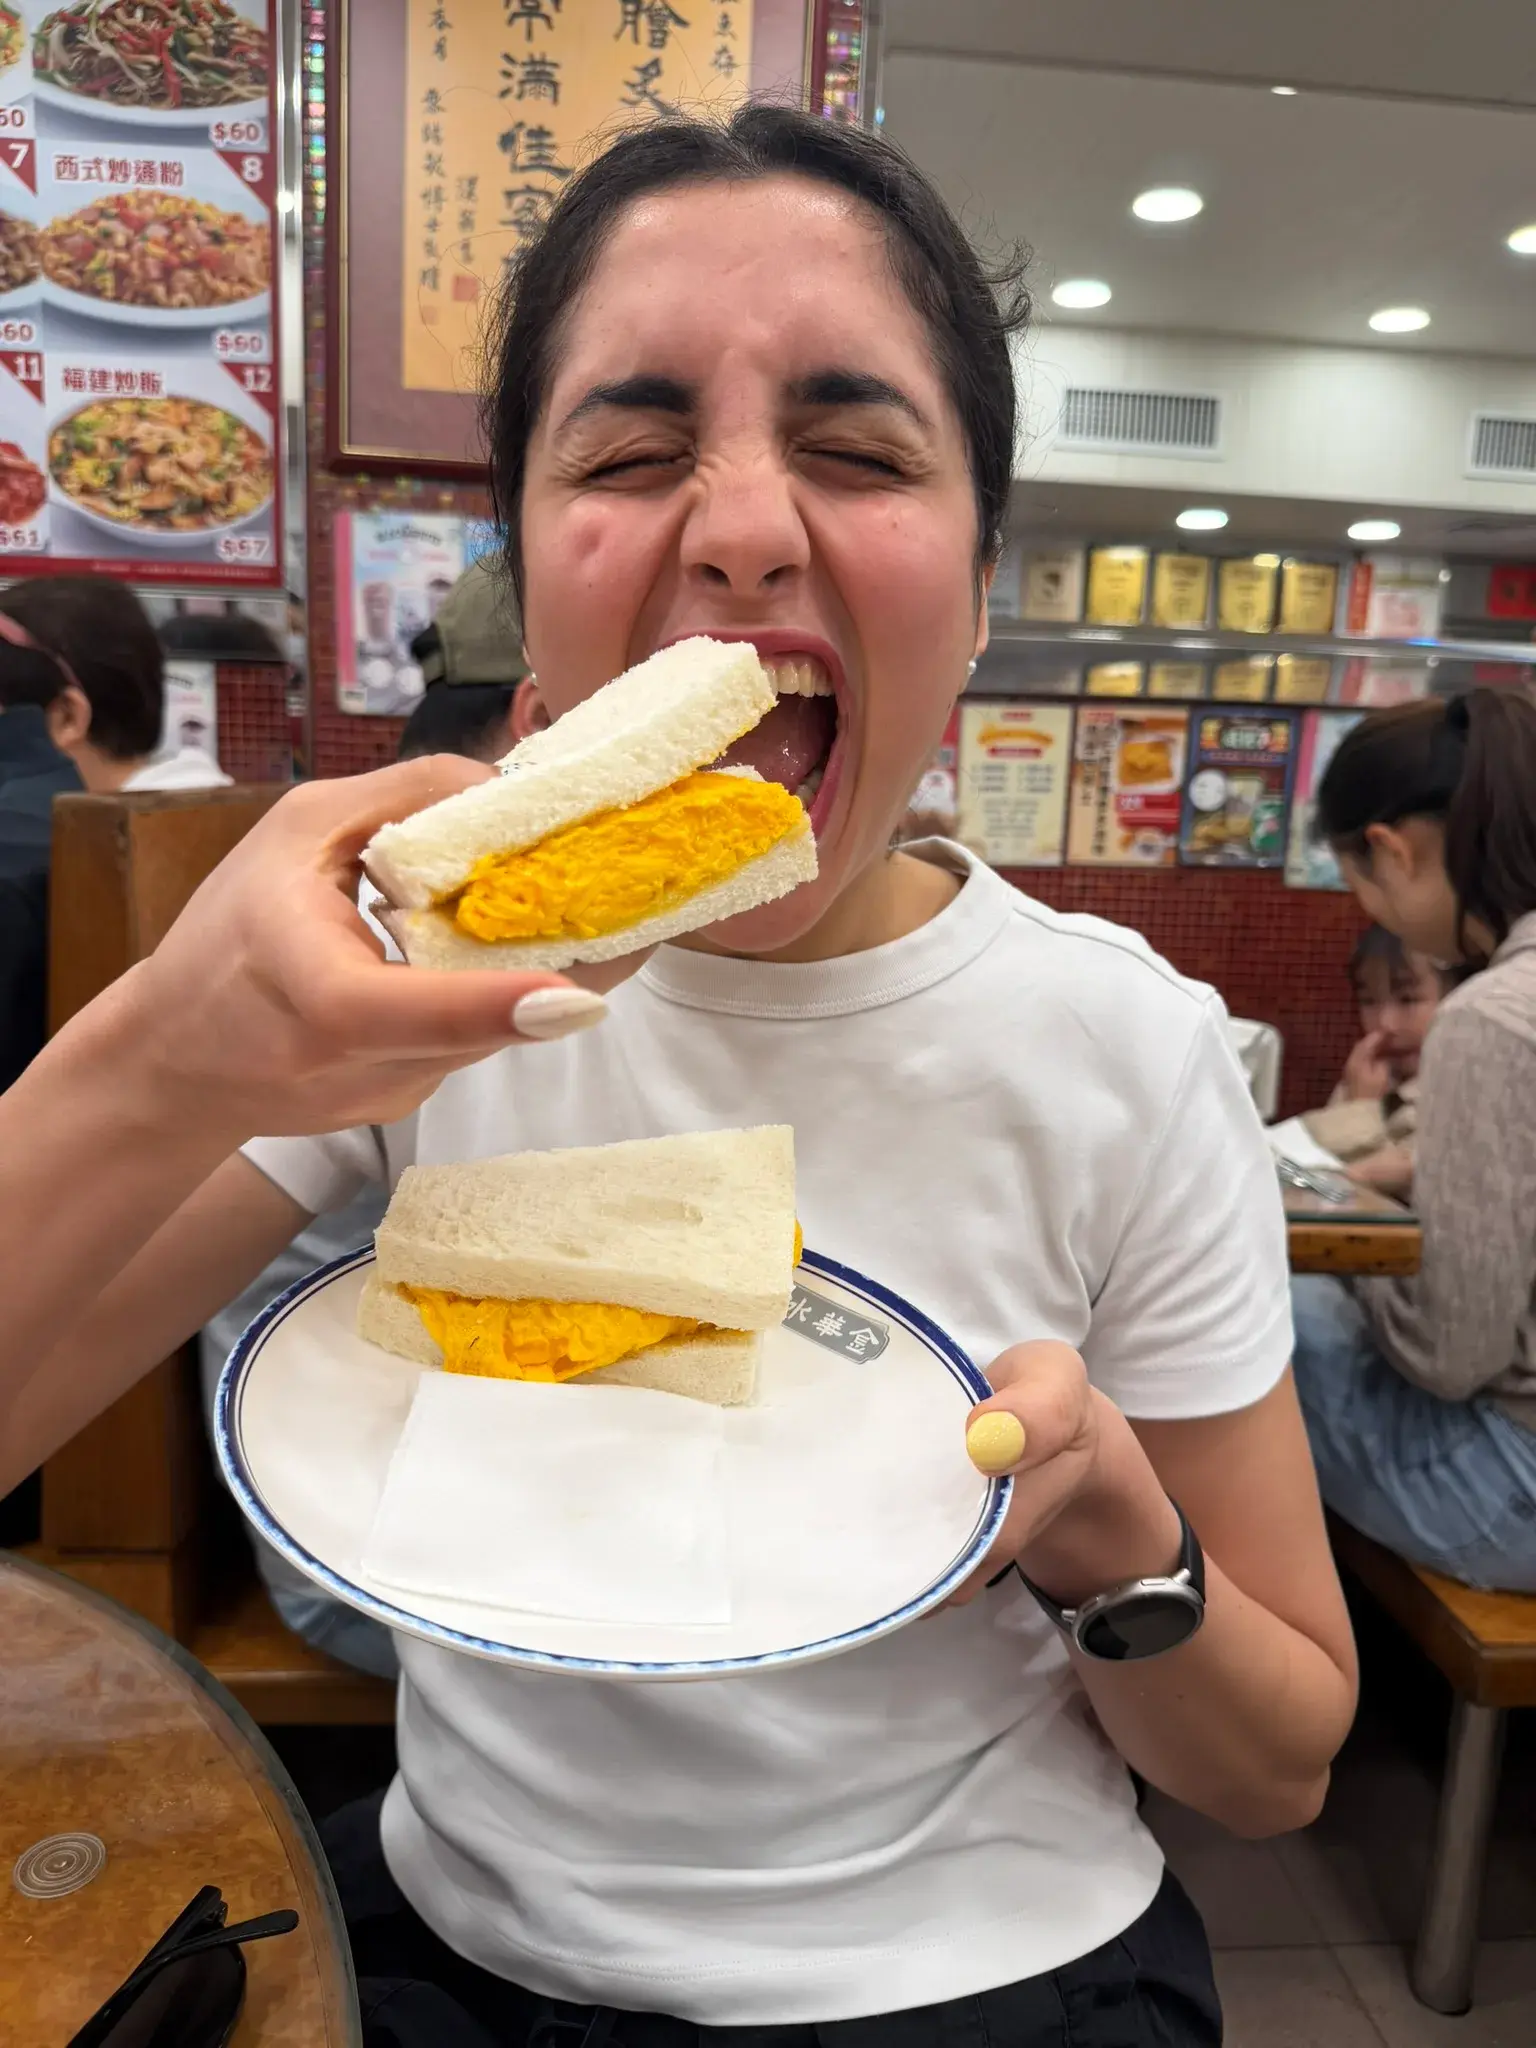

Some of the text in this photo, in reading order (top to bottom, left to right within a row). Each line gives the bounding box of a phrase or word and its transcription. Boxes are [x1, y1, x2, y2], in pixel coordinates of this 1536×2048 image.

[213, 121, 261, 143] $60
[8, 142, 29, 169] 7
[242, 156, 263, 182] 8
[0, 323, 34, 342] 60
[13, 354, 43, 382] 11
[243, 365, 274, 394] 12
